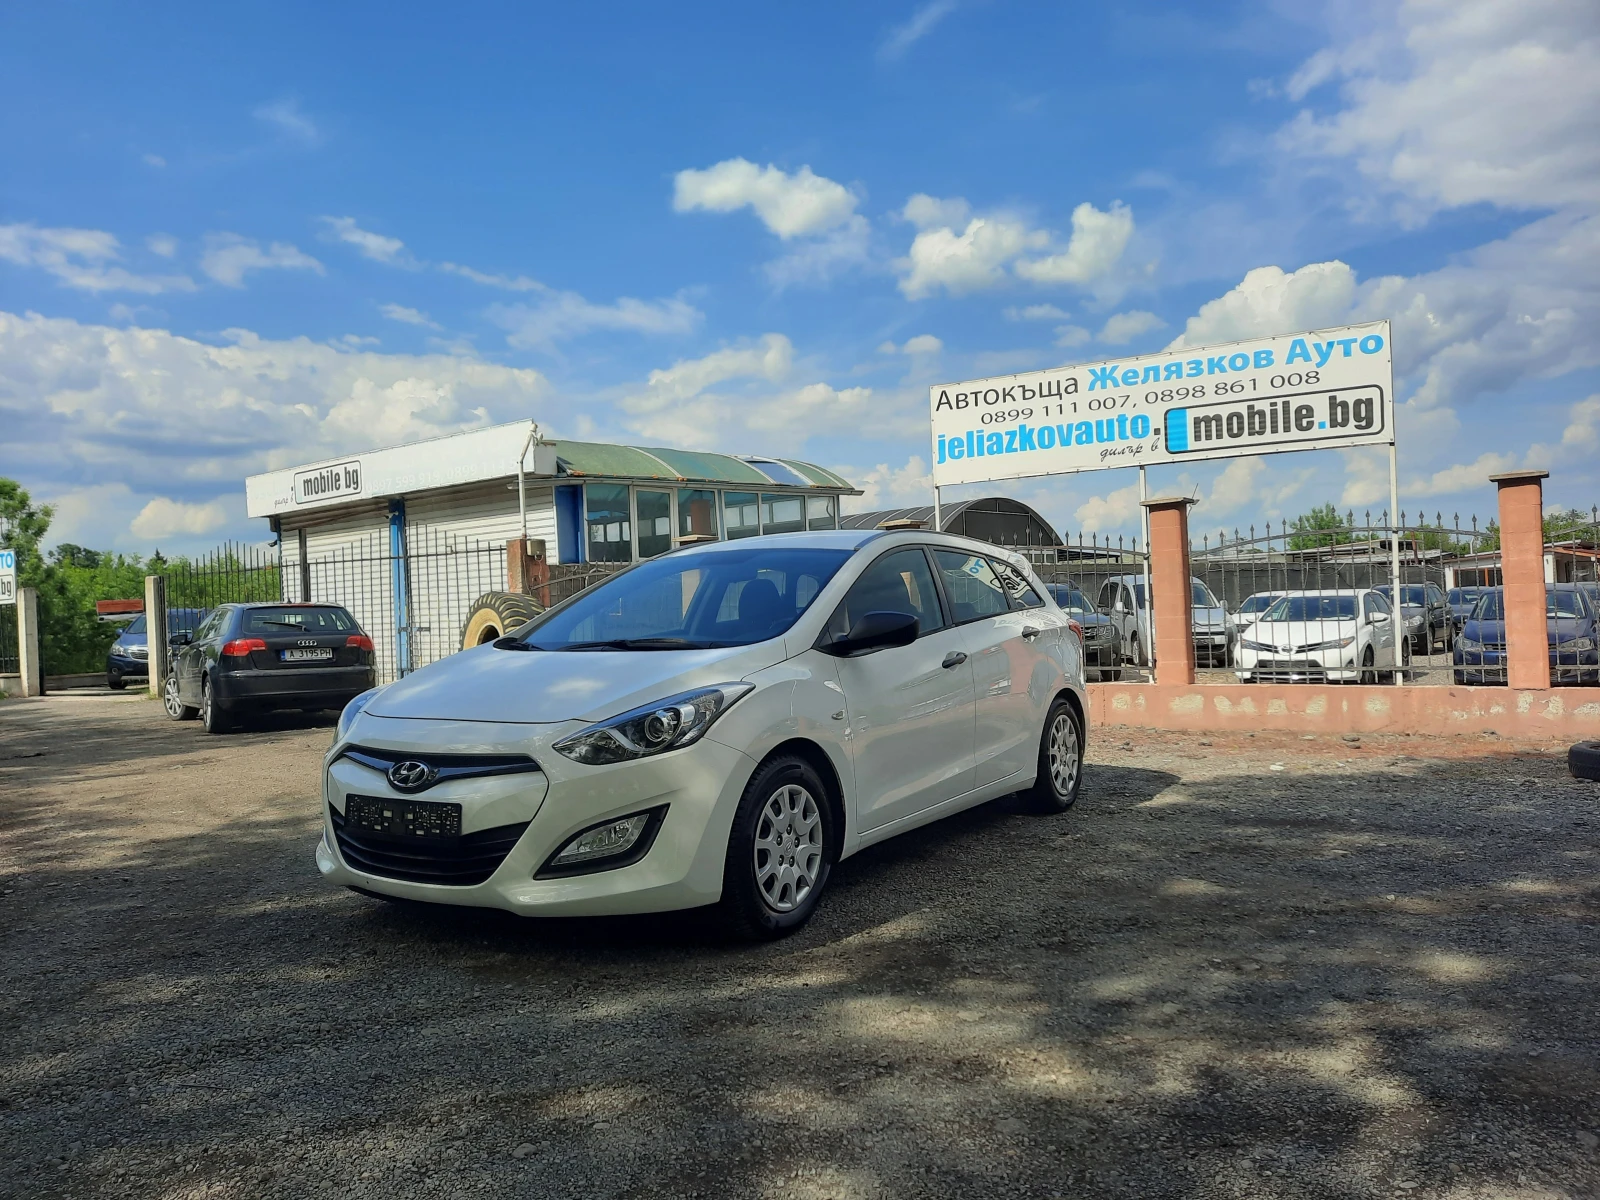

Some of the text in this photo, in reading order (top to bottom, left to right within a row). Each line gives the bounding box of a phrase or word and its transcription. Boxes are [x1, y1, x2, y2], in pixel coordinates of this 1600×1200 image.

[936, 334, 1384, 411] Автокъща Желязков Ауто
[981, 370, 1321, 424] 0899 111 007, 0898 861 008
[1193, 395, 1374, 442] mobile.bg
[1100, 443, 1143, 462] дилър
